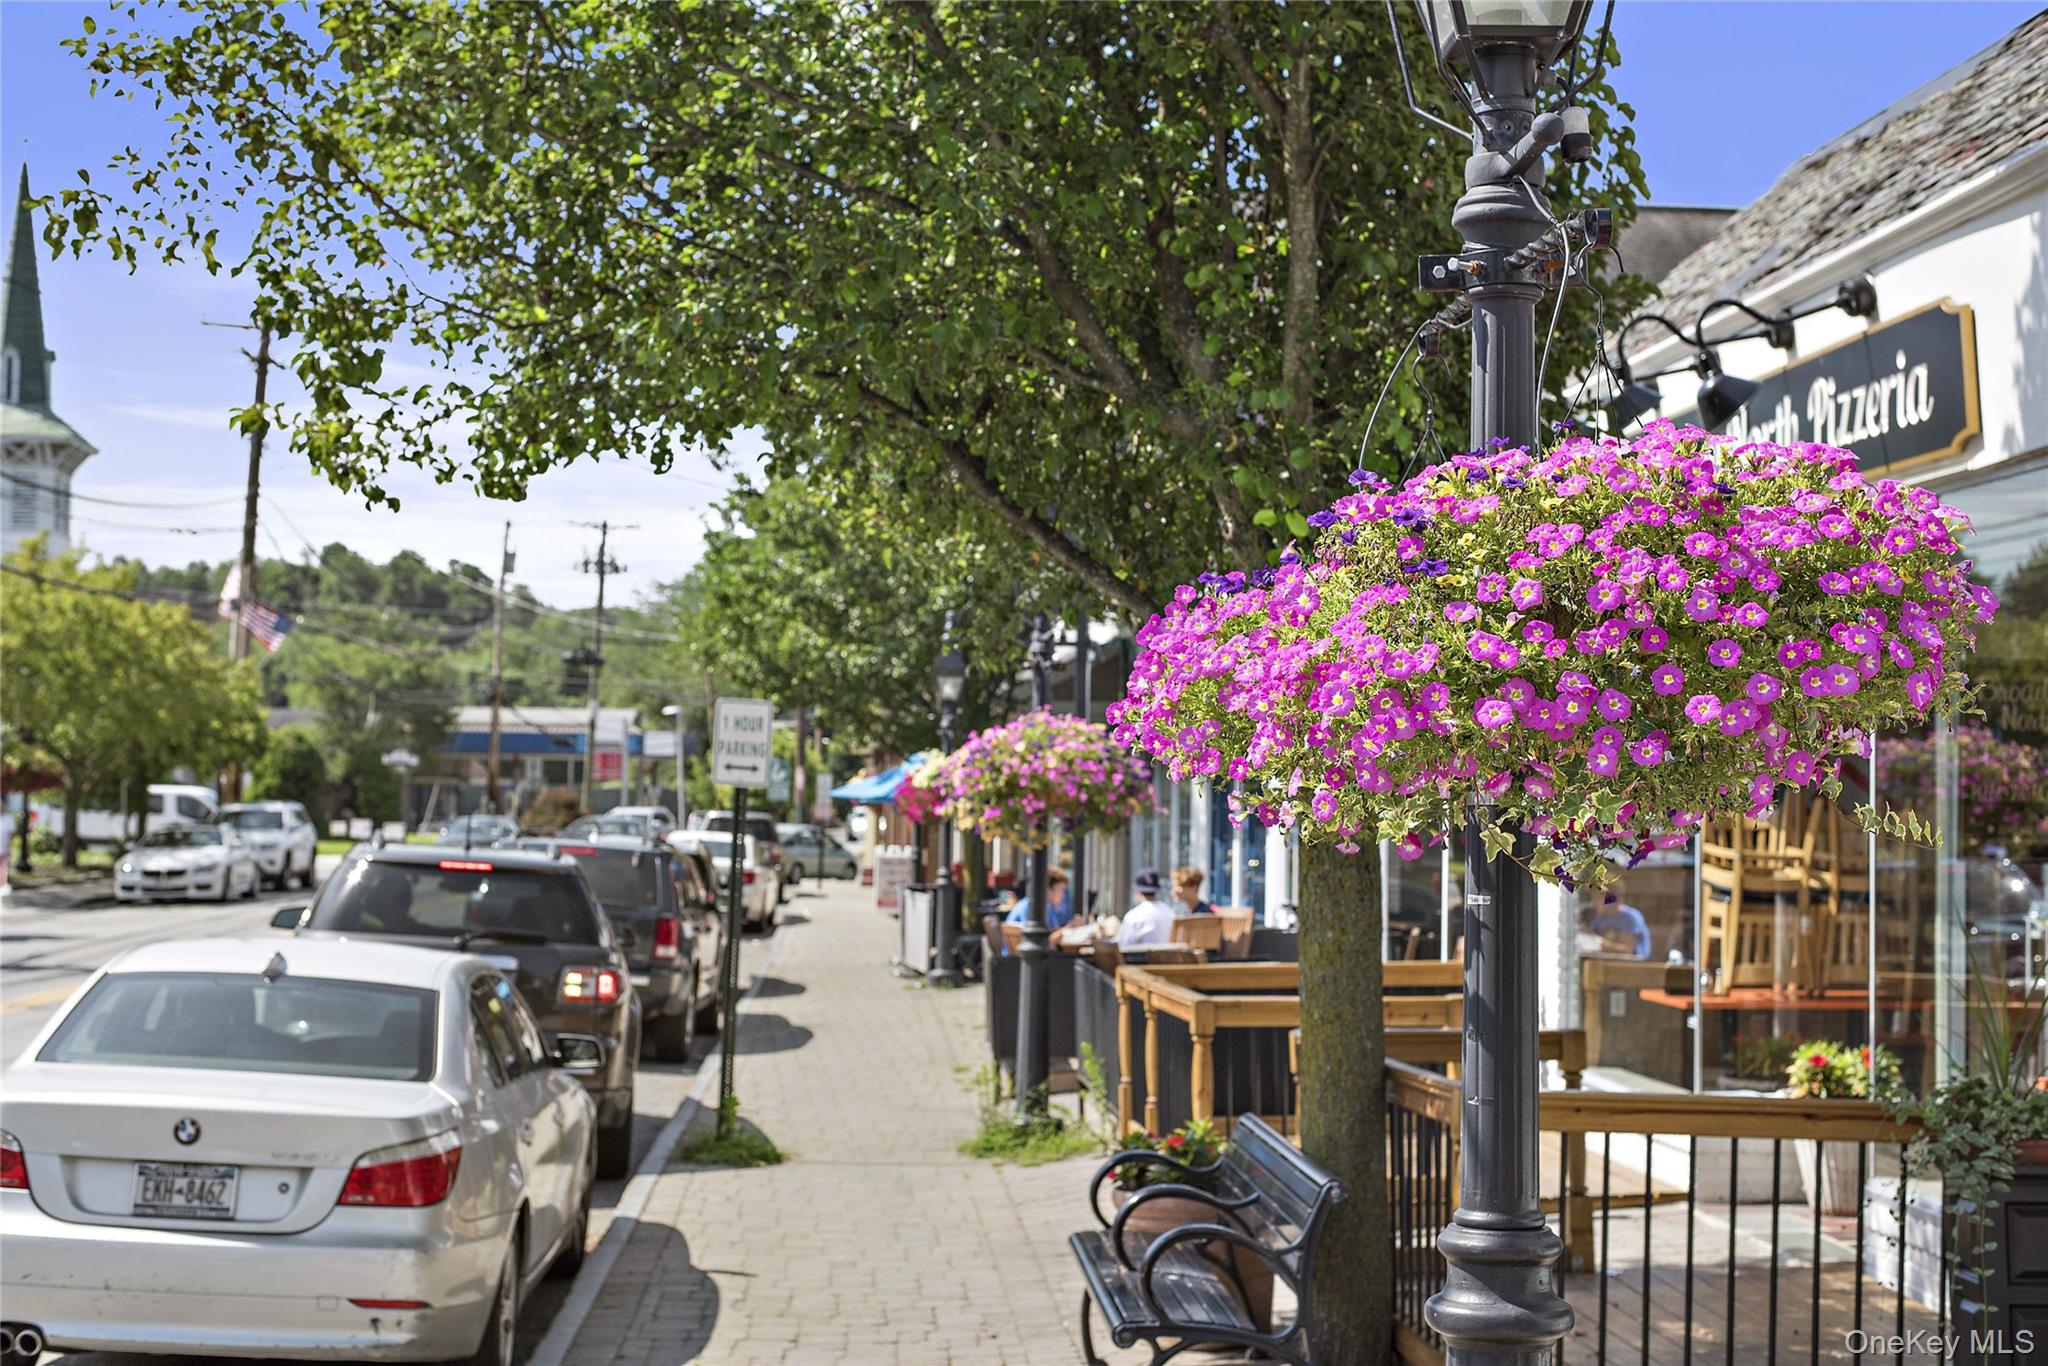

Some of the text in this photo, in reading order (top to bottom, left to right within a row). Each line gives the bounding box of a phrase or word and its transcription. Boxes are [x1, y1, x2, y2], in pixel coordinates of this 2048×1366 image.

[1807, 349, 1935, 447] Pizzeria
[723, 715, 763, 732] 1 HOUR
[720, 741, 767, 757] PARKING
